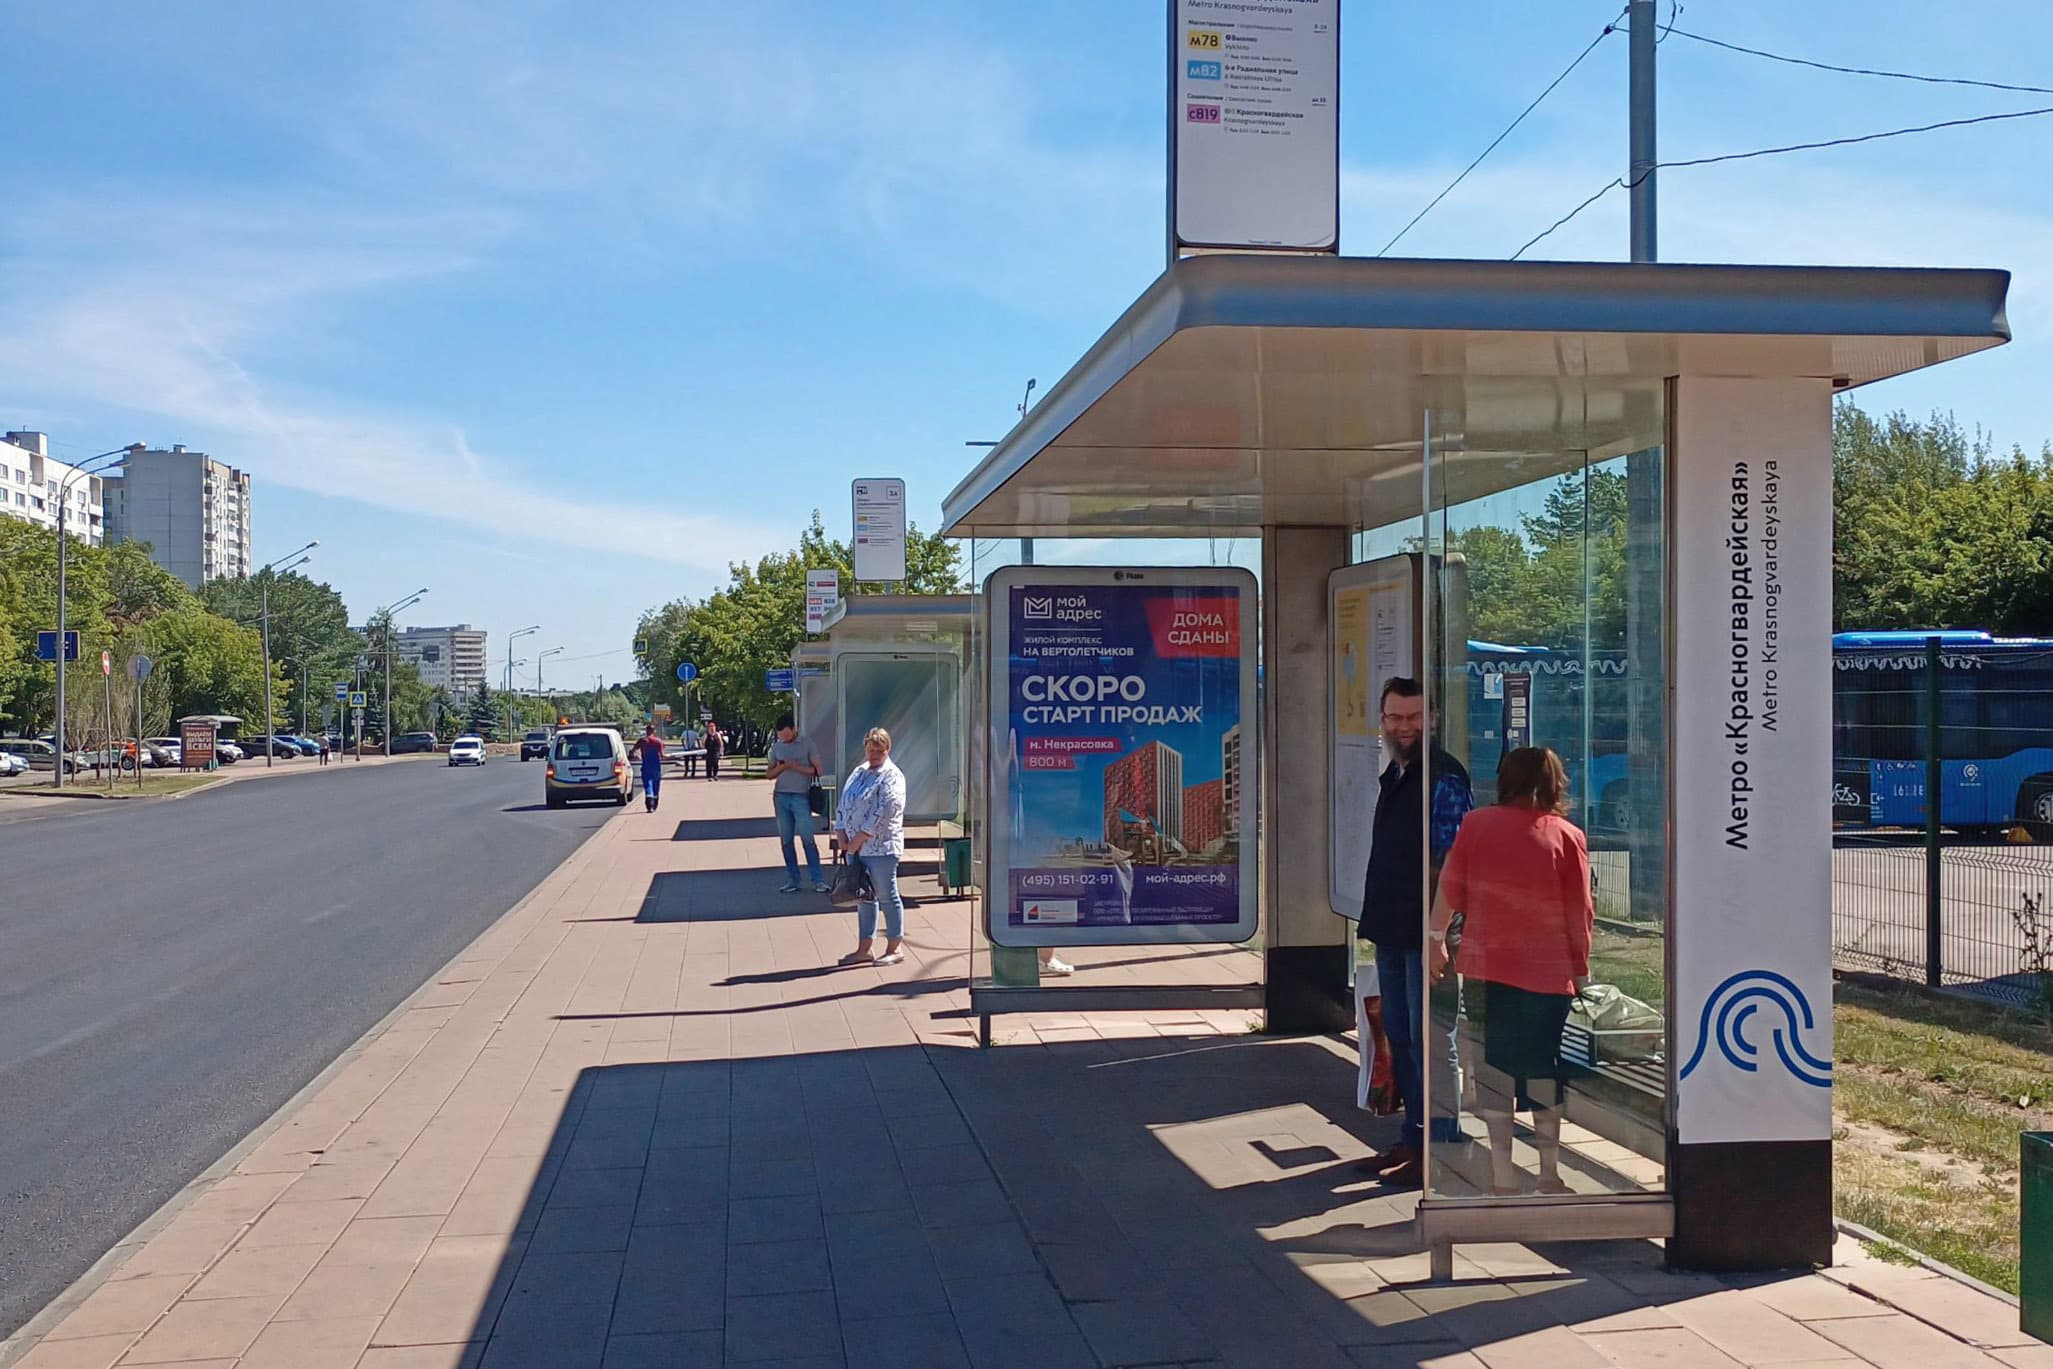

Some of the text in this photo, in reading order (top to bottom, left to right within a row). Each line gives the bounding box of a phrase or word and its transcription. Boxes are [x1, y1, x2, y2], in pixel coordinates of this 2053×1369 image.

[1189, 34, 1219, 47] м78
[1189, 64, 1217, 77] м82
[1188, 107, 1218, 120] с819
[1056, 595, 1087, 607] мой
[1761, 460, 1781, 732] Metro Krasnogvardeyskaya
[1056, 609, 1103, 622] адрес
[1173, 613, 1224, 627] ДОМА
[1023, 636, 1103, 644] ЖИЛОЙ КОМПЛЕКС
[1168, 631, 1230, 645] СДАНЫ
[1023, 647, 1135, 657] НА ВЕРТОЛЕТЧИКОВ
[1725, 461, 1754, 850] Метро «Красногвардейская»
[1022, 675, 1146, 702] СКОРО
[1023, 705, 1203, 726] СТАРТ ПРОДАЖ
[1043, 739, 1114, 751] Некрасовка
[1022, 873, 1114, 887] (495) 151-02-91
[1145, 872, 1227, 885] мой-адрес.рф
